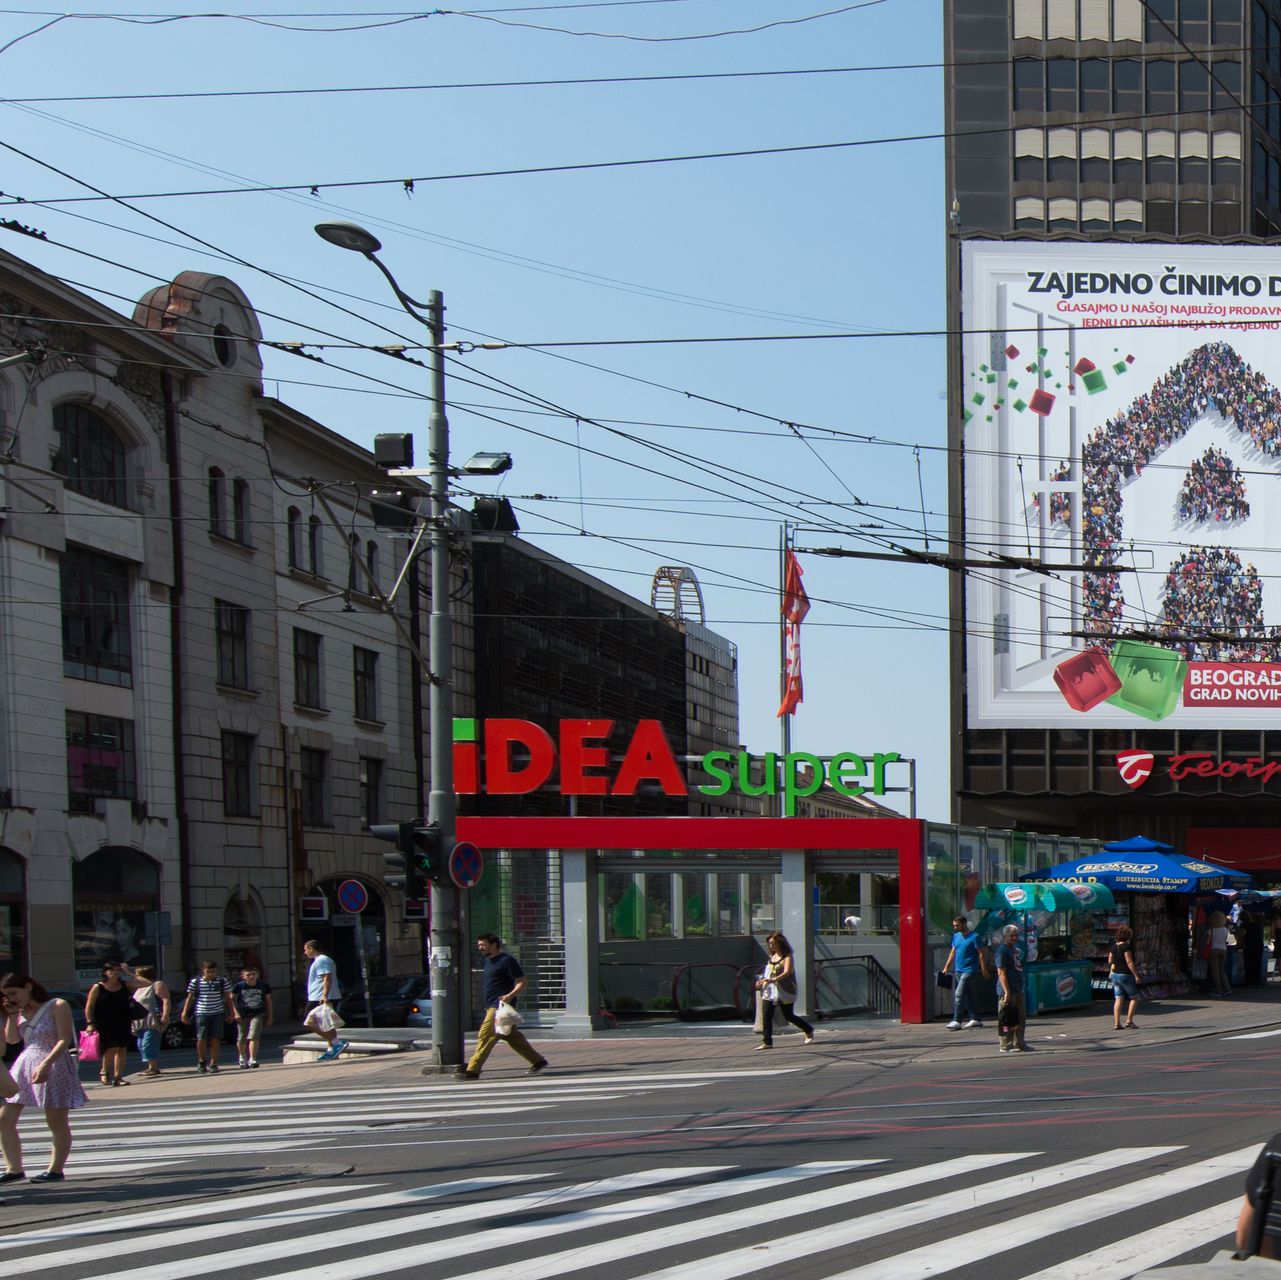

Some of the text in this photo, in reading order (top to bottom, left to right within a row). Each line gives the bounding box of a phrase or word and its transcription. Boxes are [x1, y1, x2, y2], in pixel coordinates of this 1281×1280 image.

[1026, 271, 1154, 299] ZAJEDNO
[1159, 266, 1262, 297] ČINIMO
[1120, 304, 1130, 313] U
[1131, 301, 1168, 315] NAŠOJ
[1170, 302, 1227, 316] NAJBLIŽOJ
[1119, 318, 1137, 328] OD
[1228, 320, 1279, 332] ZAJEDNO
[1190, 687, 1232, 701] GRAD
[700, 749, 901, 817] super
